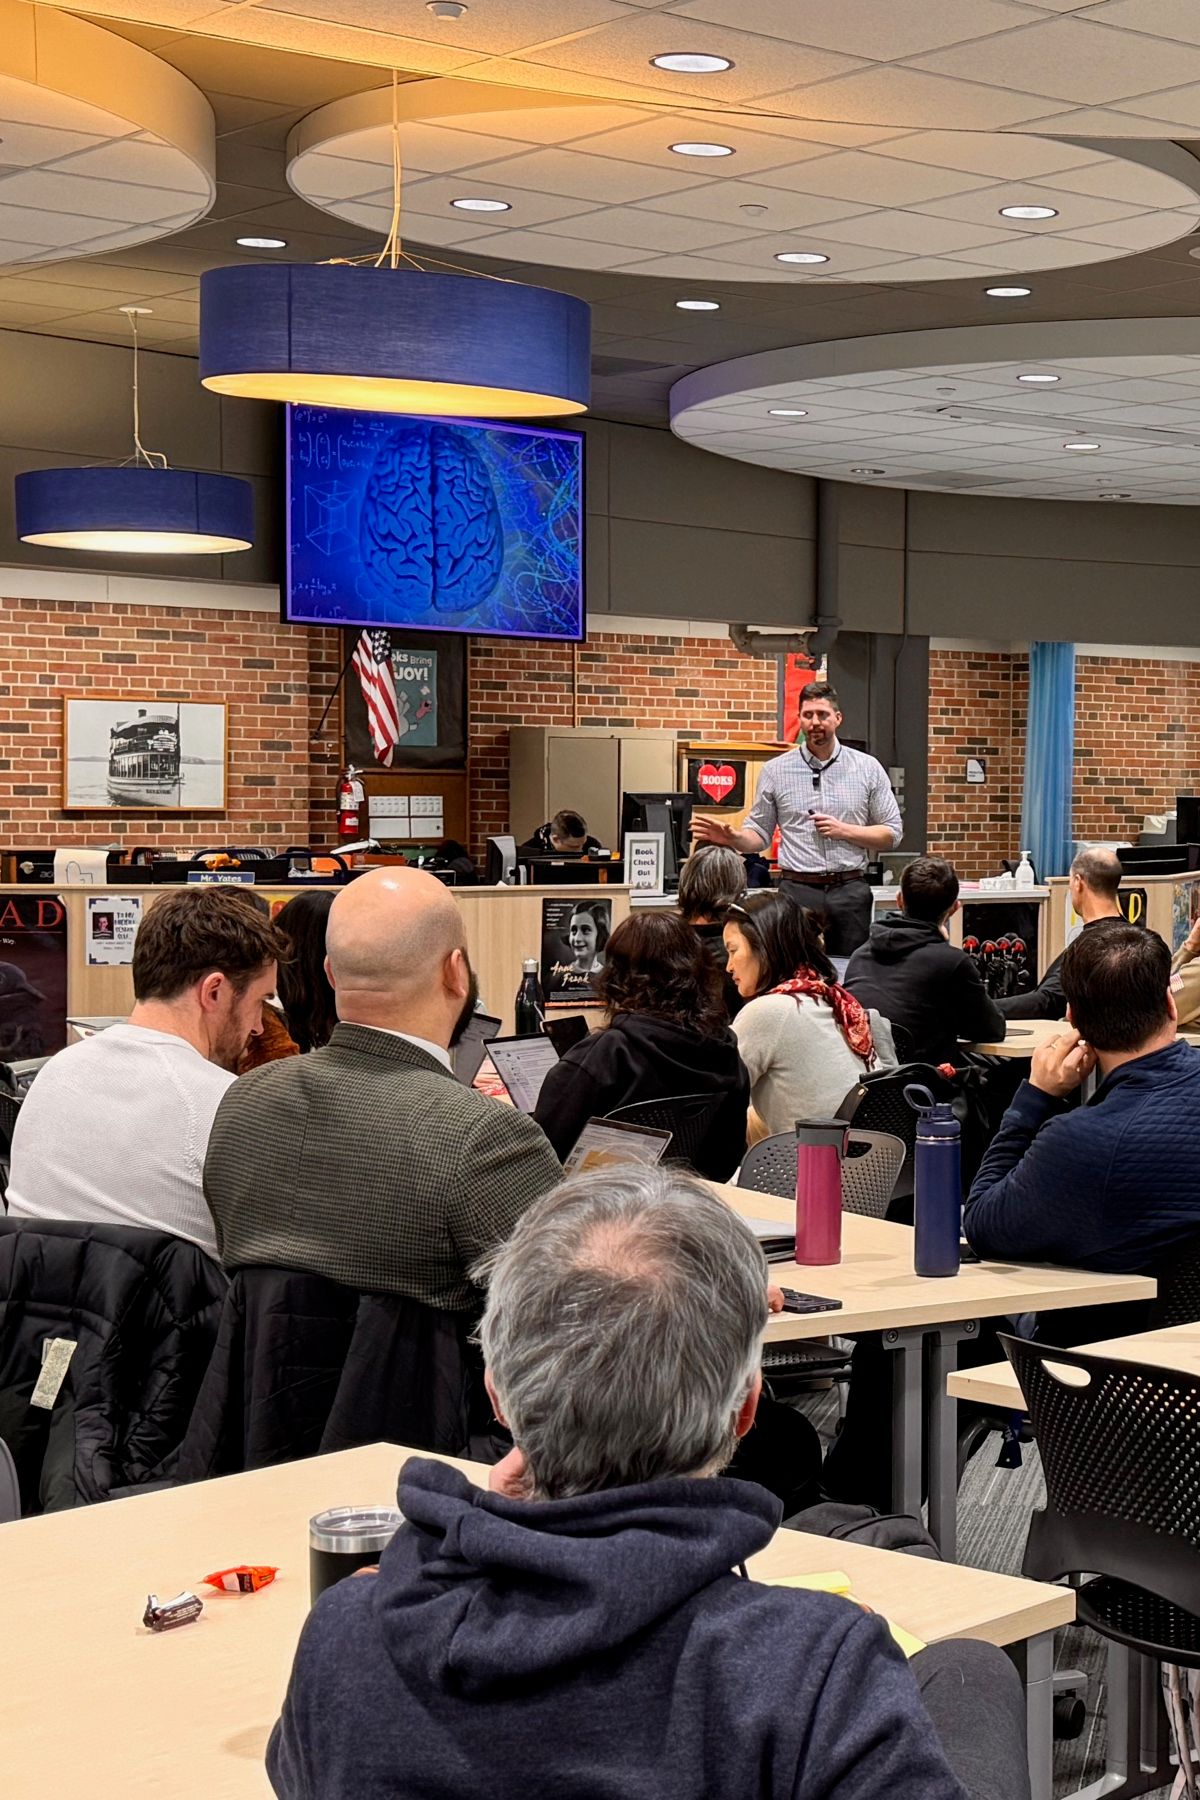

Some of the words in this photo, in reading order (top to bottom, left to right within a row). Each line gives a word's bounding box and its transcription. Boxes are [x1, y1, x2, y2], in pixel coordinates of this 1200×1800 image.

[410, 656, 432, 667] Bring
[394, 667, 429, 681] JOY!
[702, 774, 734, 786] BOOKS
[635, 848, 655, 856] Book
[633, 859, 656, 867] Check
[200, 874, 214, 882] Mr.
[217, 874, 242, 882] Yates
[550, 961, 574, 977] Anne
[561, 972, 590, 987] Frank
